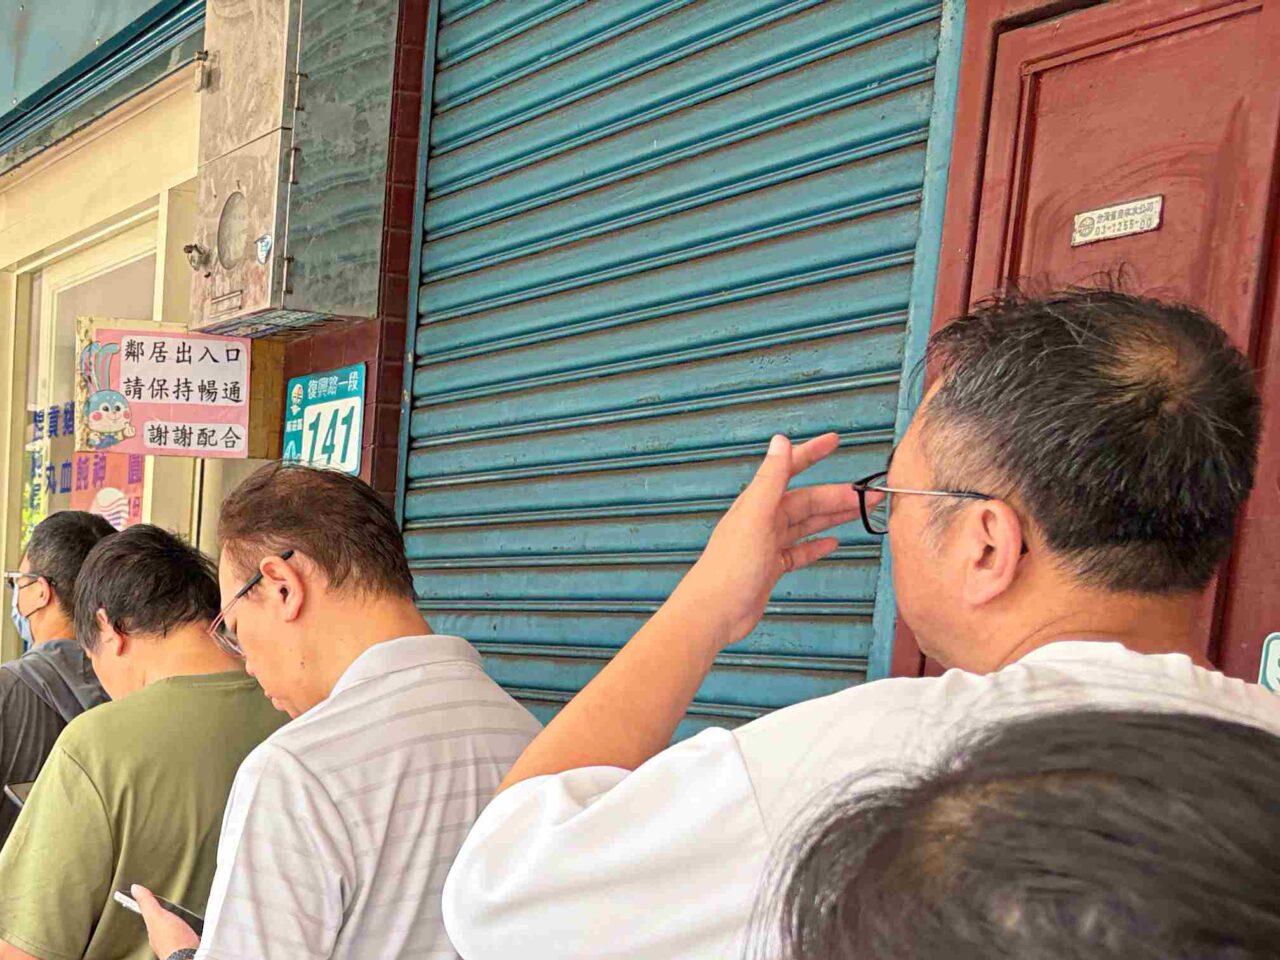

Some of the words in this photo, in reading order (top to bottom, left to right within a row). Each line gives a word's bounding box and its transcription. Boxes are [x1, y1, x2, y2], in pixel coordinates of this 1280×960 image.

[124, 339, 241, 364] 鄰居出入口
[123, 376, 243, 403] 請保持暢通
[148, 424, 241, 449] 謝謝配合
[308, 405, 355, 466] 141
